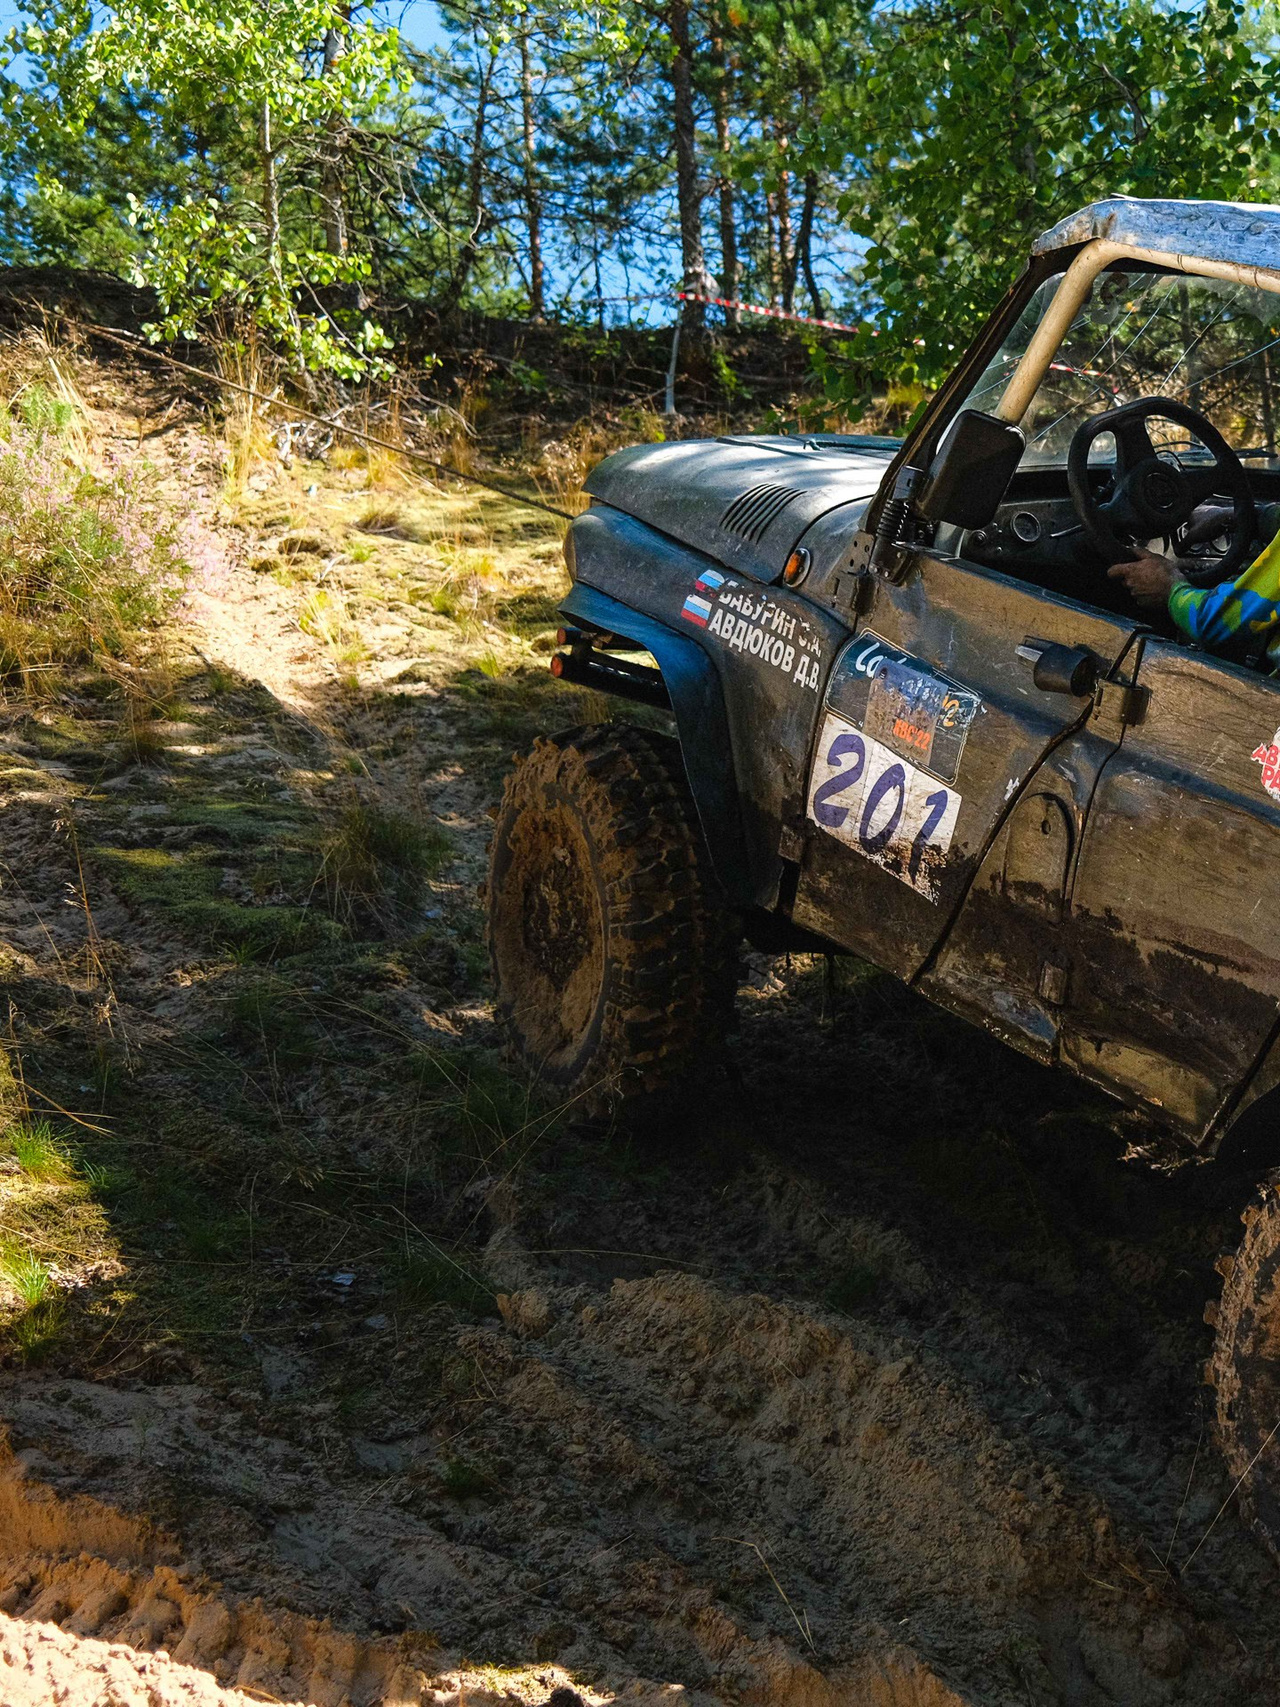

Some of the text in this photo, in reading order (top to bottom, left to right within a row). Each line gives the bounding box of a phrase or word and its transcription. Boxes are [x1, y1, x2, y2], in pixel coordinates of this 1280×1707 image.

[708, 608, 796, 673] АВДЮКОВ
[793, 654, 819, 692] Д.В.
[813, 734, 949, 885] 201
